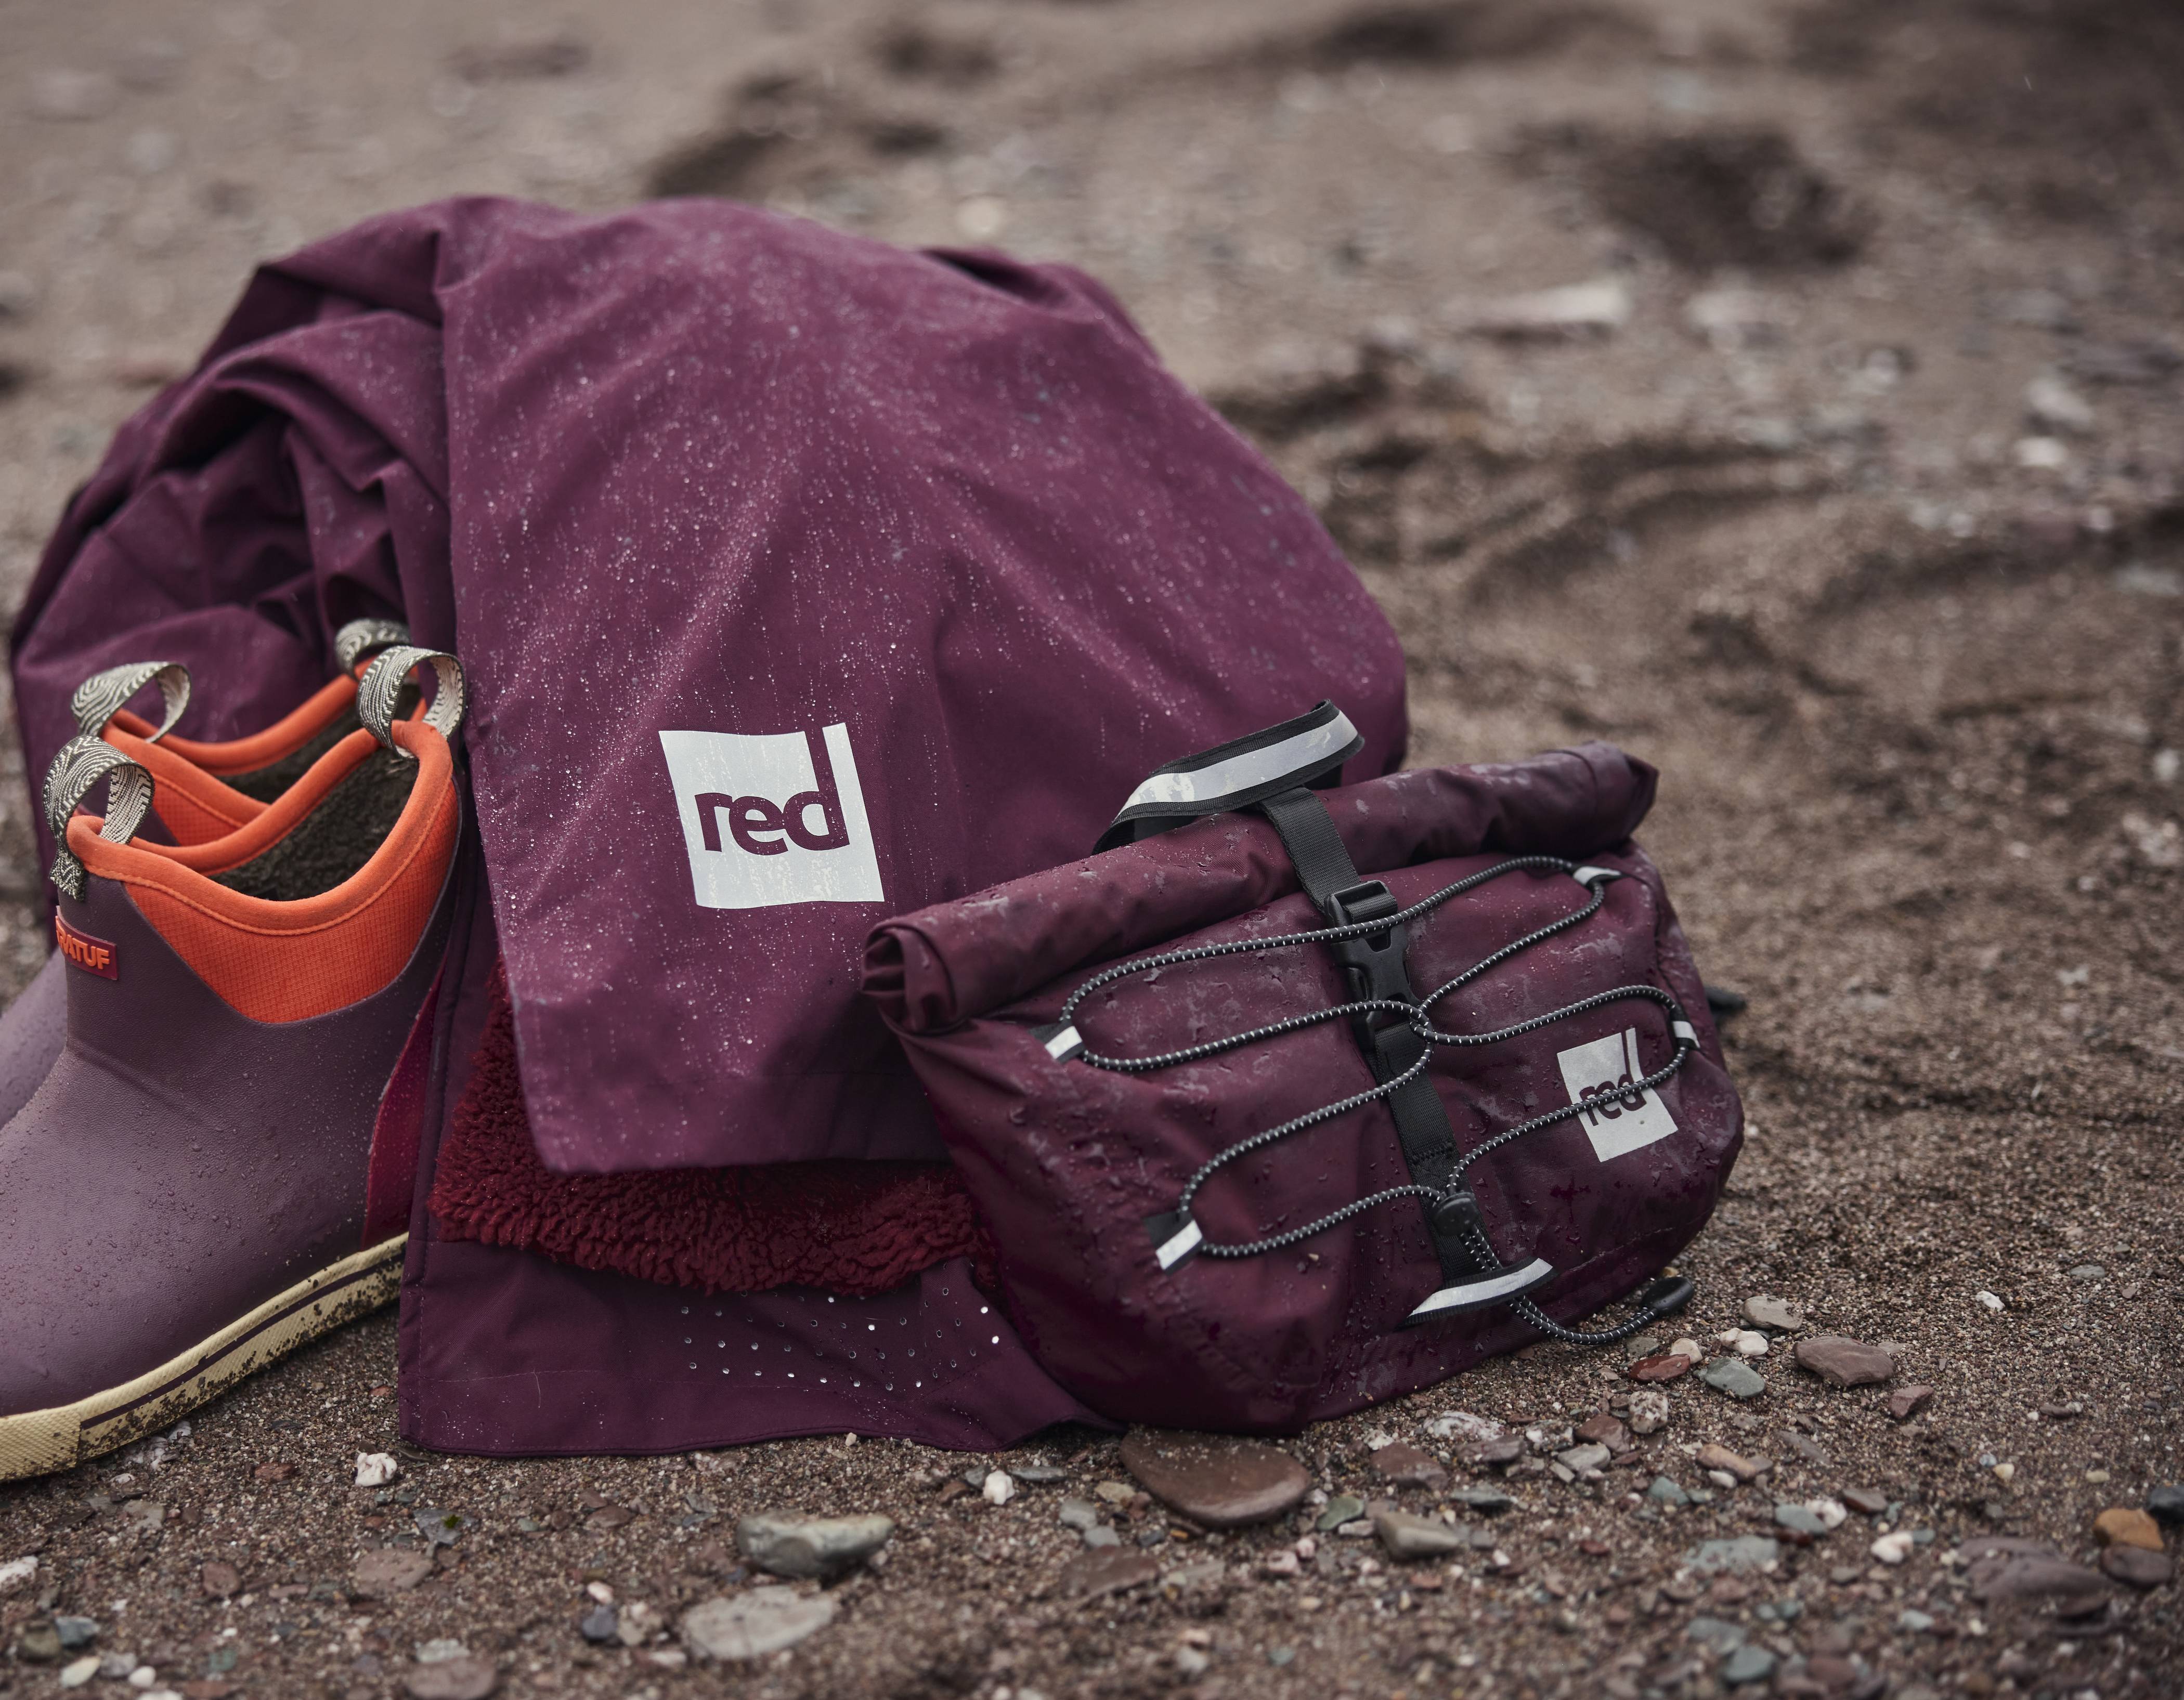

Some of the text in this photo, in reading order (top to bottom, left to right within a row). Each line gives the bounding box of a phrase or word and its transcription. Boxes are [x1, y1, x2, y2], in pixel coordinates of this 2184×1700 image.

[694, 727, 850, 856] red
[55, 916, 110, 970] RATUF
[1579, 1029, 1647, 1126] red
